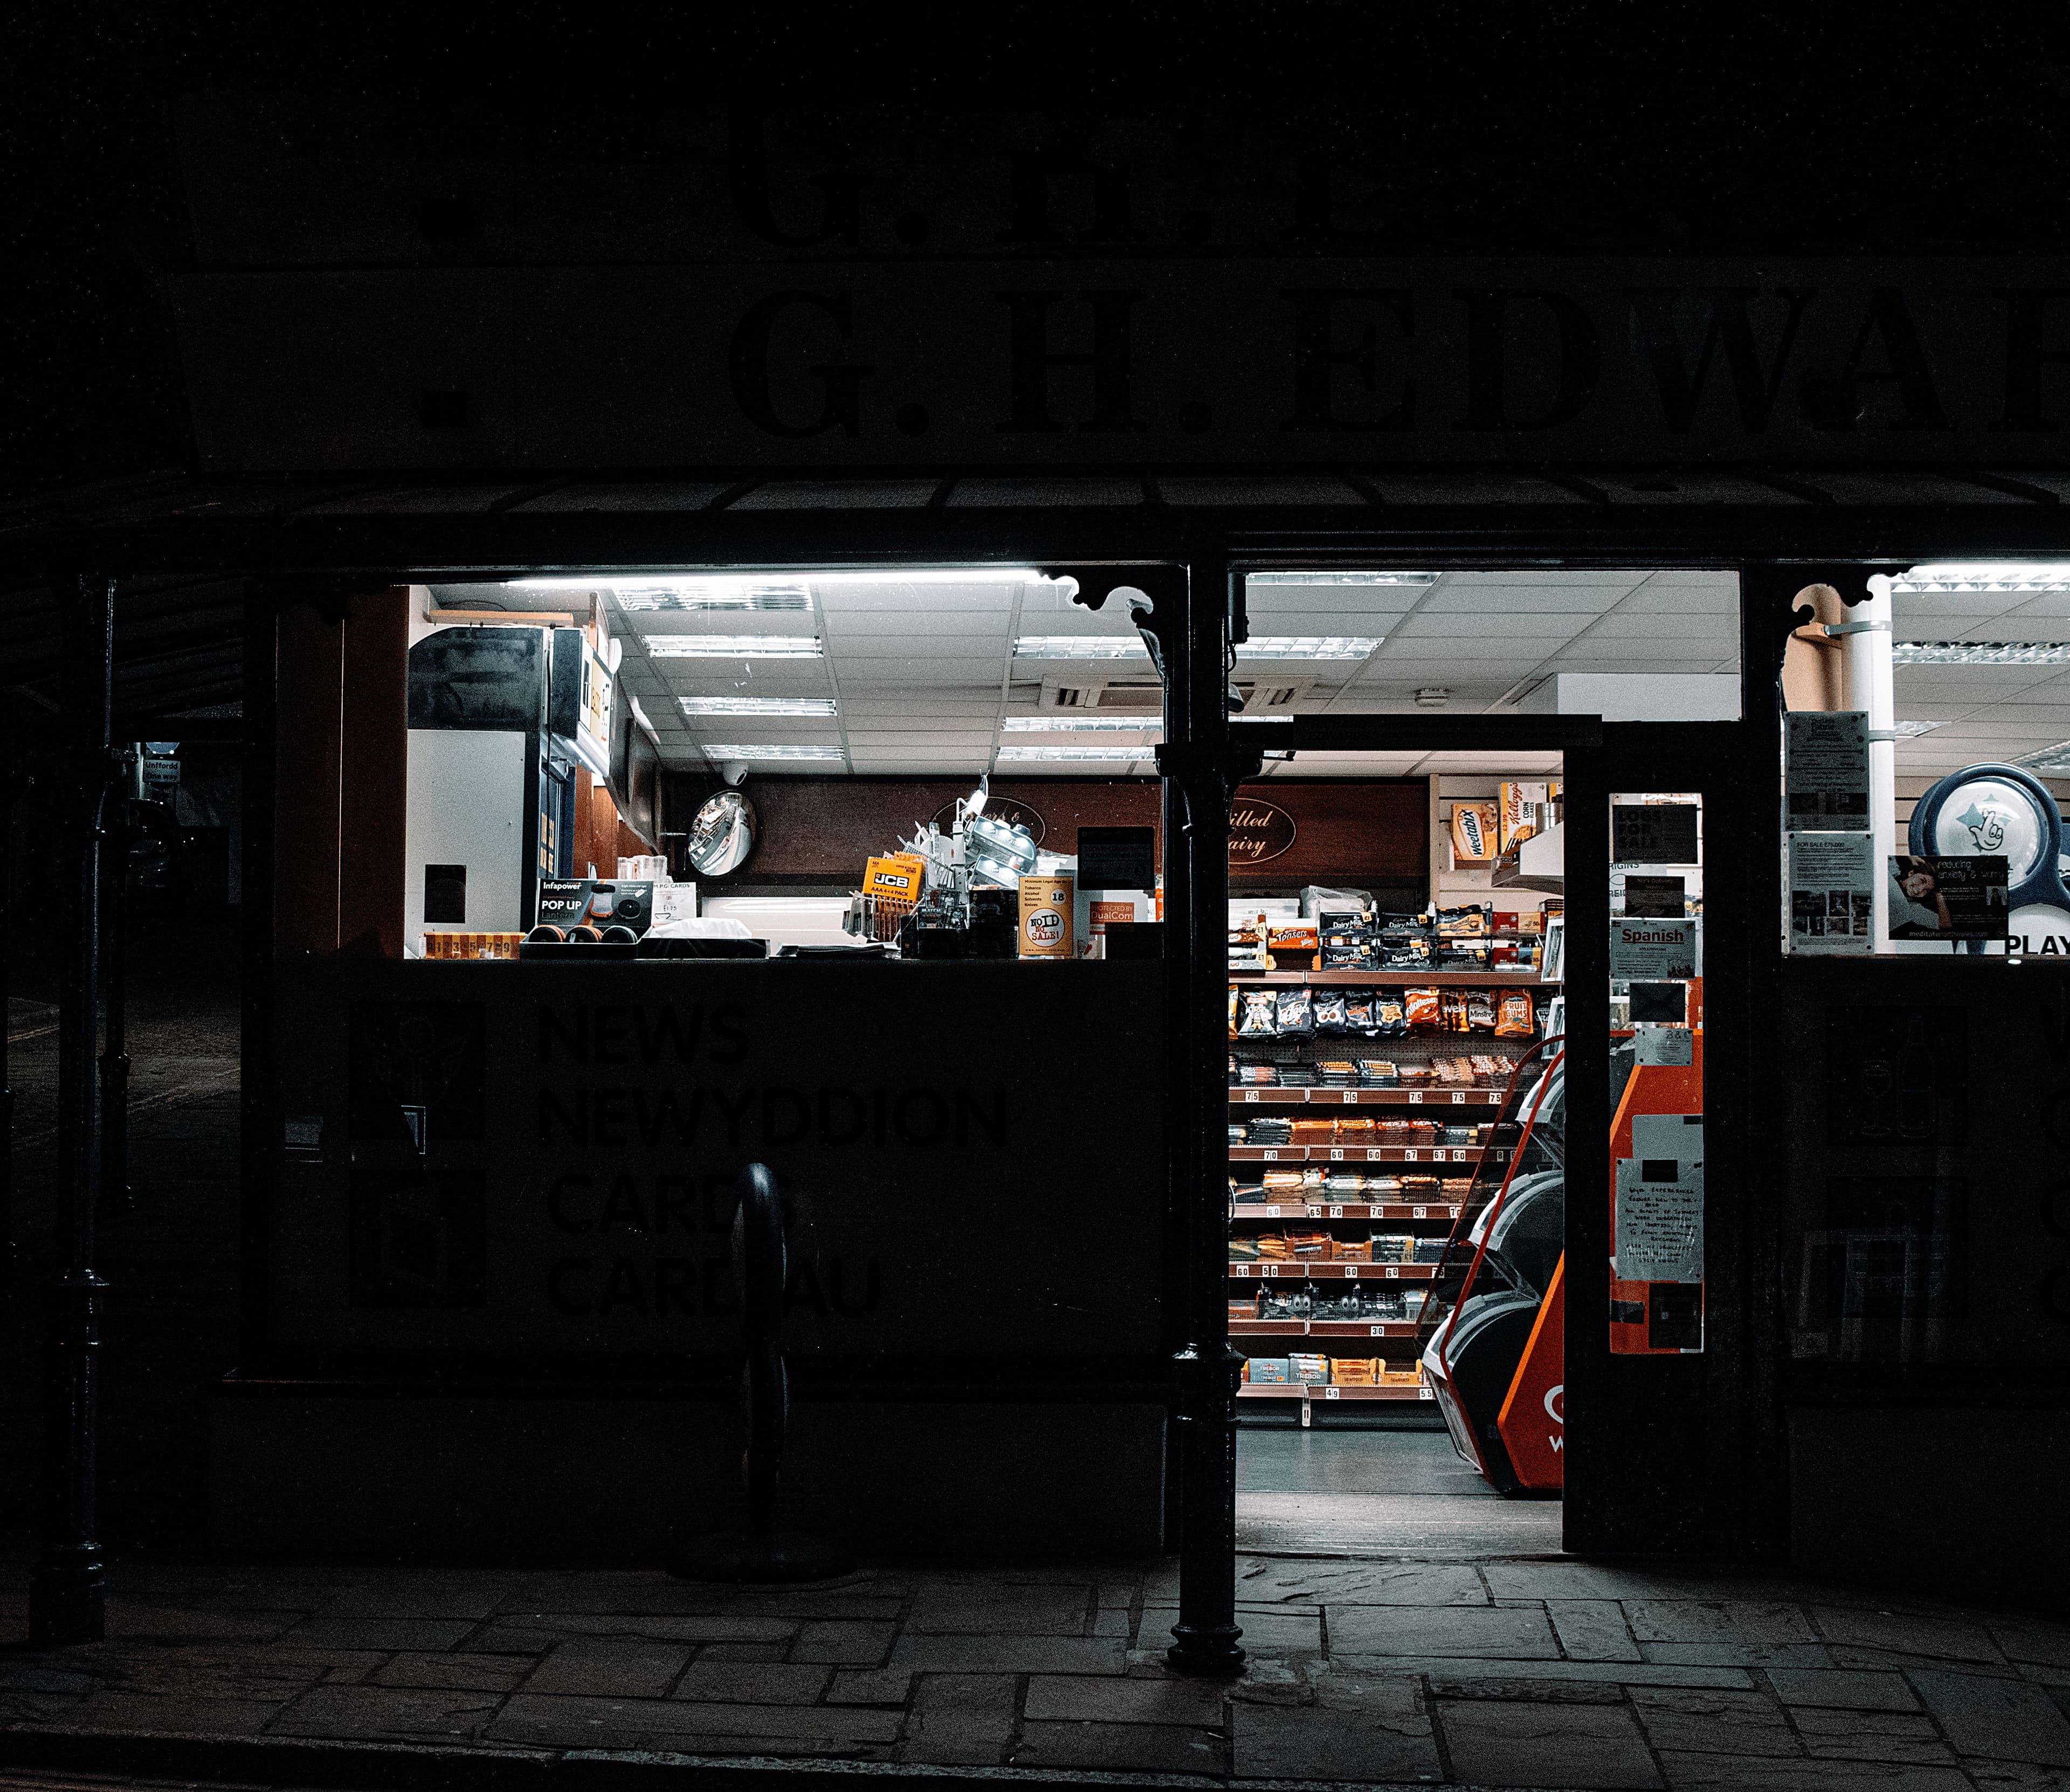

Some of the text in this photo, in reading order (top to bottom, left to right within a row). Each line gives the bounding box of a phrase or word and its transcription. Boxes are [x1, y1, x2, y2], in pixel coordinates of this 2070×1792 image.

[730, 288, 929, 437] G.
[995, 288, 1212, 433] H.
[1508, 783, 1523, 825] Kellogg's
[1461, 808, 1483, 856] Weetabix
[1619, 824, 1650, 835] FOR
[1619, 836, 1657, 848] SALE
[1937, 861, 1971, 871] reducing
[1937, 870, 1966, 881] anxiety
[1969, 870, 1977, 879] &
[874, 874, 909, 888] JCB
[543, 882, 582, 891] Infapower
[1052, 893, 1065, 901] 18
[541, 900, 582, 911] POP UP
[1091, 911, 1134, 919] DualCom
[1030, 914, 1060, 928] NO ID
[1333, 921, 1350, 929] Dairy
[1032, 931, 1059, 940] SALE!
[1276, 930, 1308, 943] Teasers
[1622, 929, 1683, 943] Spanish
[453, 942, 459, 952] 3
[470, 942, 477, 952] 5
[487, 942, 493, 952] 7
[503, 942, 510, 953] 9
[1333, 954, 1350, 962] Dairy
[1392, 954, 1409, 963] Dairy
[1406, 997, 1438, 1017] Maltesers
[1505, 1001, 1527, 1010] FRUIT
[1506, 1009, 1527, 1018] GUMS
[540, 1004, 752, 1065] NEWS
[1247, 1092, 1258, 1101] 75
[1345, 1093, 1356, 1102] 75
[1453, 1094, 1464, 1102] 75
[1491, 1094, 1501, 1102] 75
[540, 1086, 1008, 1148] NEWYDDION
[1369, 1150, 1379, 1159] 60
[1406, 1151, 1416, 1159] 67
[1454, 1151, 1465, 1159] 60
[1268, 1208, 1279, 1216] 60
[1310, 1208, 1321, 1216] 65
[1331, 1208, 1341, 1216] 70
[1371, 1208, 1382, 1216] 70
[1264, 1267, 1277, 1276] 50
[1387, 1268, 1397, 1277] 60
[1327, 1389, 1338, 1397] 49
[1420, 1389, 1432, 1397] 55
